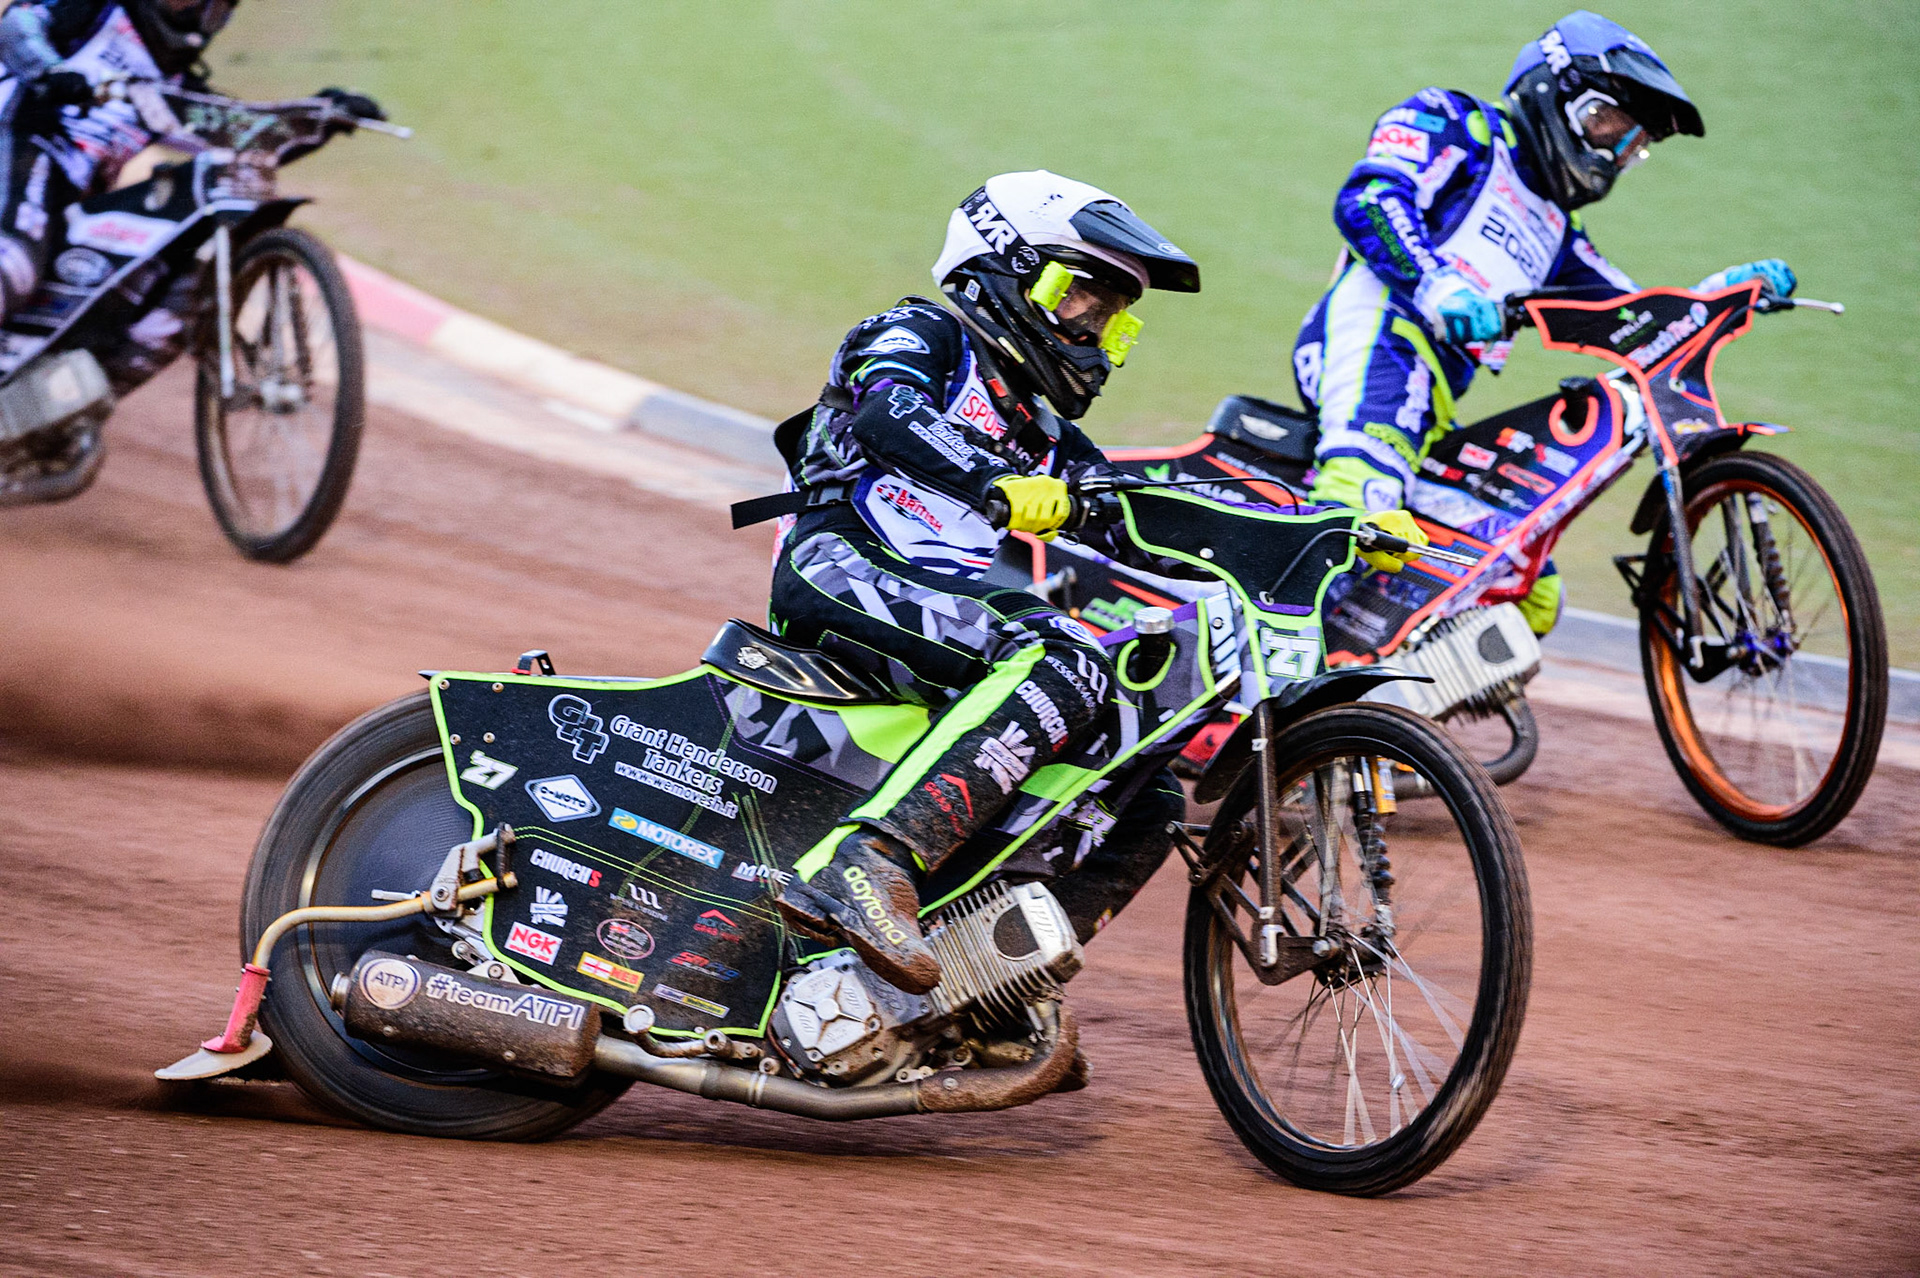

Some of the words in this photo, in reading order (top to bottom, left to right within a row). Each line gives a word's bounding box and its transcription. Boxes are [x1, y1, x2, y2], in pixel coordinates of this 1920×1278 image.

[895, 494, 943, 533] BRITISH
[1260, 627, 1322, 681] 27
[459, 749, 520, 791] 27
[609, 714, 669, 749] Grant
[664, 732, 778, 794] Henderson
[641, 748, 725, 795] Tankers
[636, 820, 720, 866] MOTOREX
[842, 865, 910, 945] daytona
[511, 926, 558, 955] NGK
[371, 970, 409, 992] ATPI
[426, 972, 587, 1031] #teamATPI
